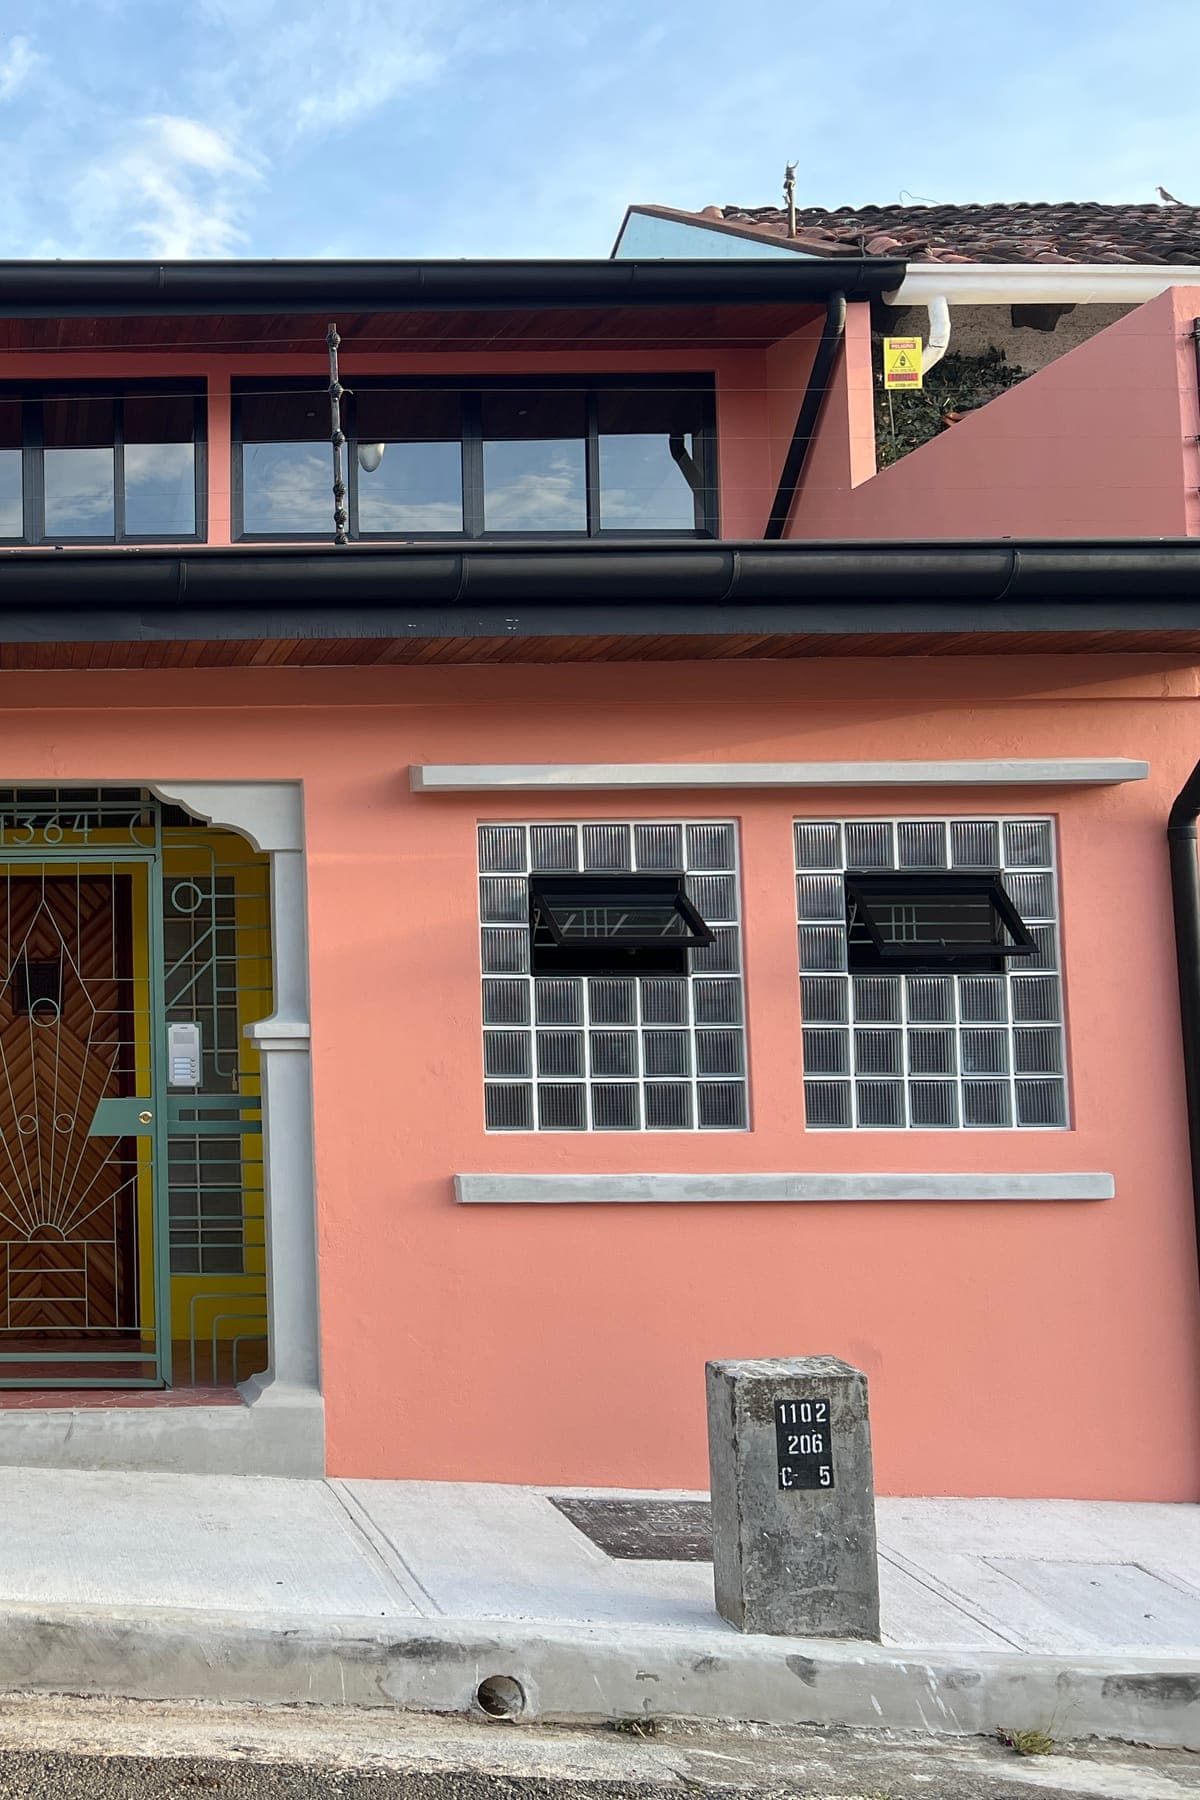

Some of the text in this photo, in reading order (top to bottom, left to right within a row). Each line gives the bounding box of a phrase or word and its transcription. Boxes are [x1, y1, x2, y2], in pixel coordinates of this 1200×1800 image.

[780, 1403, 827, 1424] 1102
[788, 1433, 823, 1454] 206
[819, 1465, 831, 1486] 5
